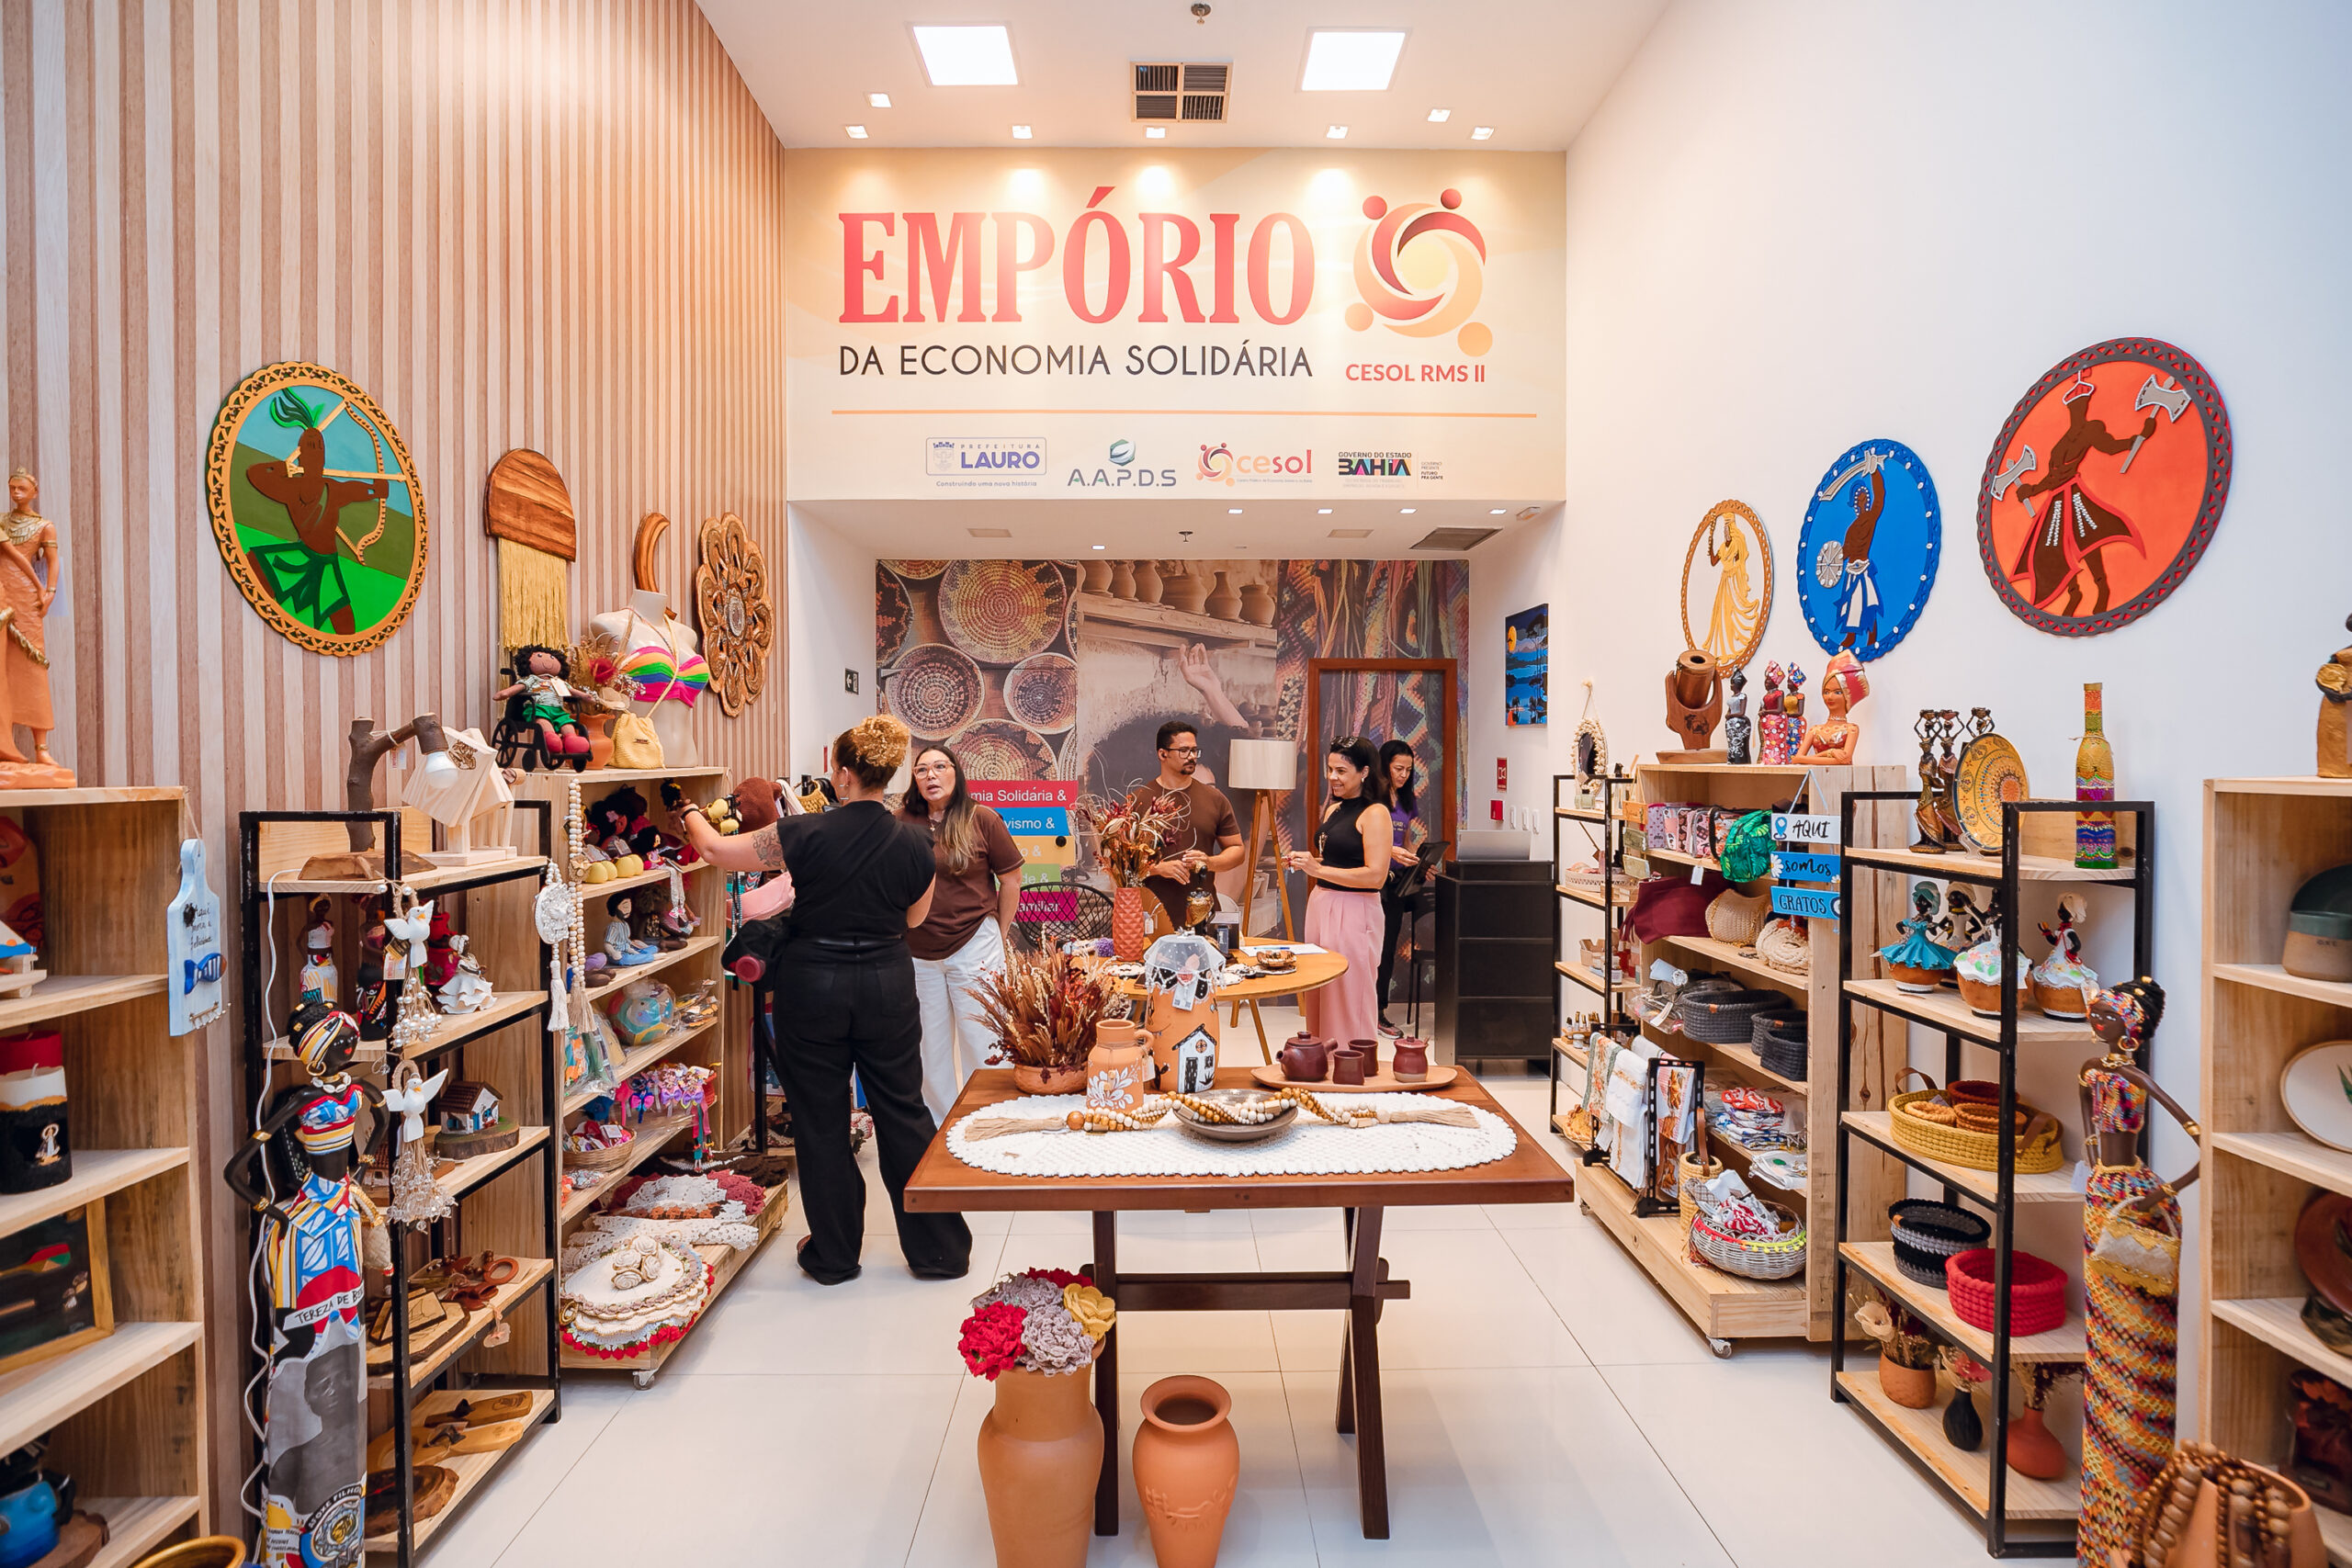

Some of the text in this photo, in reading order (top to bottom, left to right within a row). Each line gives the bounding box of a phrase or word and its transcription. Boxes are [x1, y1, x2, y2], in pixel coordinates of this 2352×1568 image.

[838, 186, 1316, 325] EMPÓRIO
[840, 340, 1313, 378] DA ECONOMIA SOLIDÁRIA
[1345, 364, 1415, 382] CESOL
[1420, 365, 1468, 383] RMS
[960, 451, 1040, 469] LAURO
[1236, 449, 1312, 474] cesol
[1338, 458, 1412, 476] BAHIA
[1067, 468, 1177, 487] A.A.P.D.S
[970, 786, 1067, 802] mia Solidária &
[1004, 818, 1055, 829] vismo &
[1792, 819, 1830, 839] AQUI
[1032, 845, 1042, 857] &
[1779, 895, 1827, 915] GRATOS
[295, 1301, 334, 1324] TEREZA
[337, 1294, 350, 1305] DE
